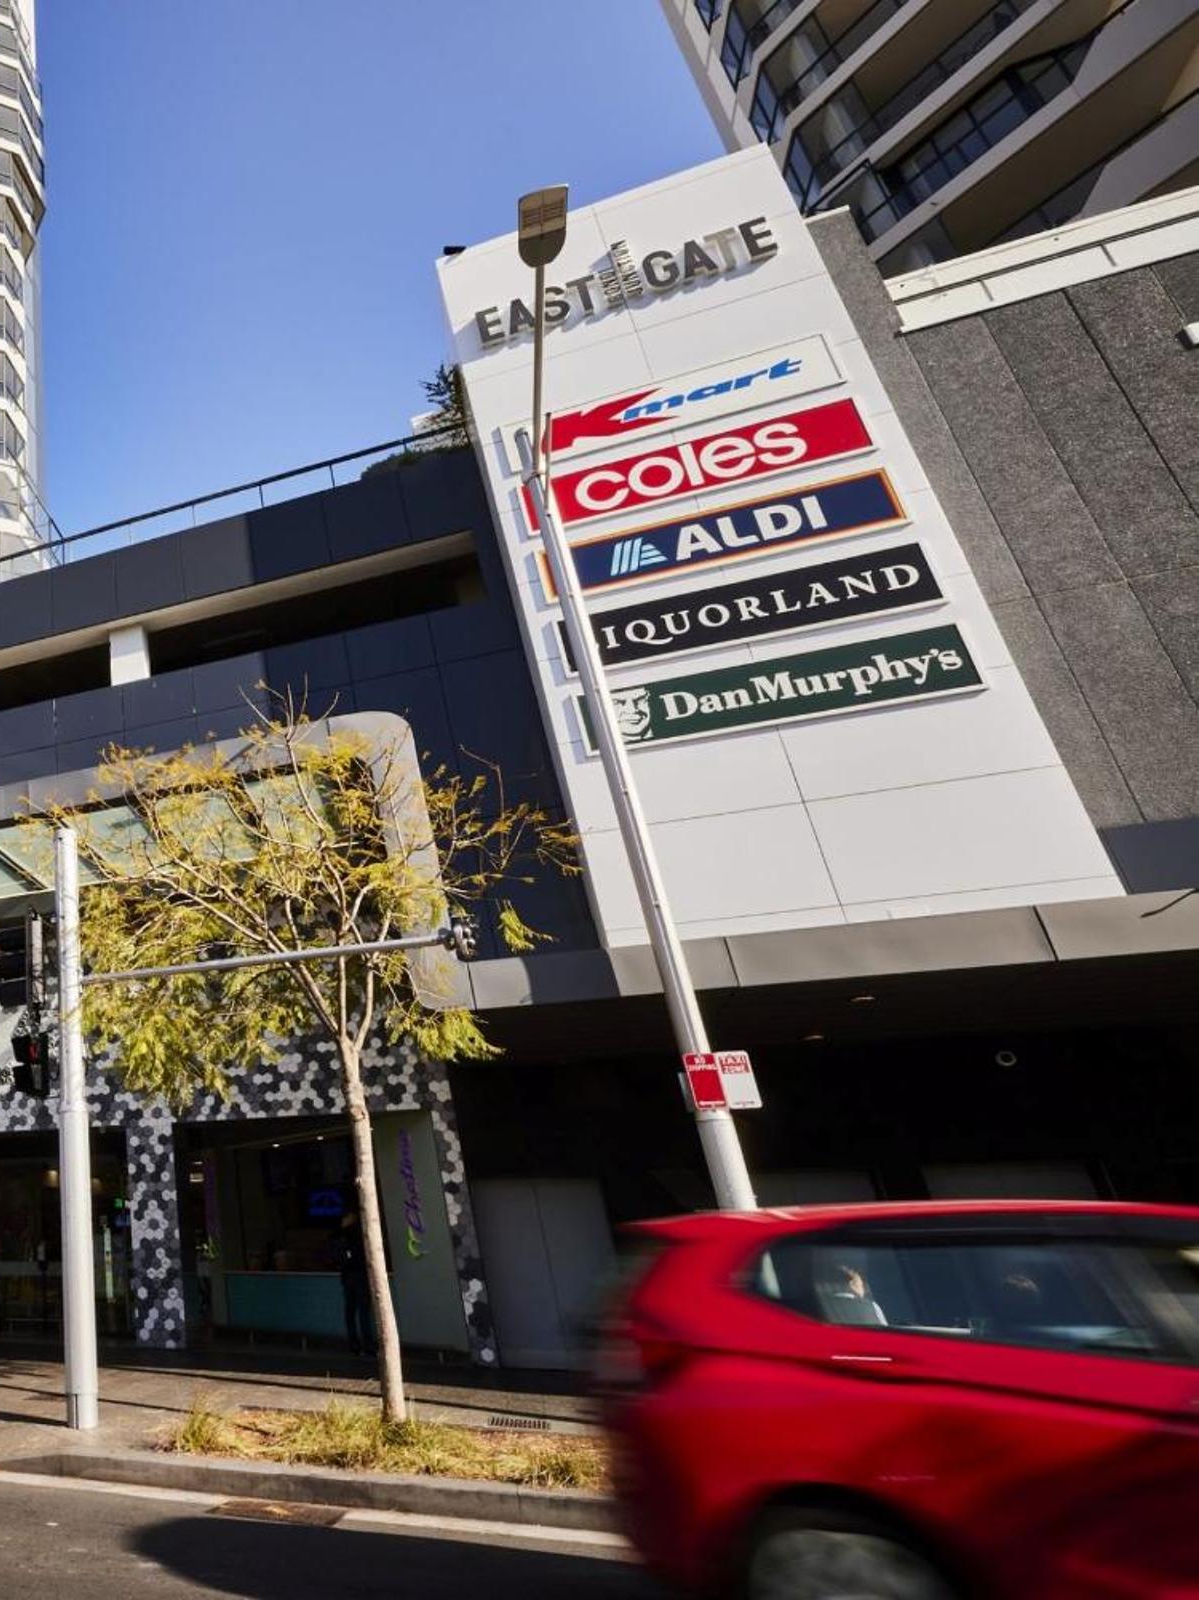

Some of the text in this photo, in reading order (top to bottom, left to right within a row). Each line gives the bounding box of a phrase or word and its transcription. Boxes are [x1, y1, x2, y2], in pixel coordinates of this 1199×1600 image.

[475, 216, 778, 344] EAST GATE
[575, 422, 808, 511] coles
[675, 496, 827, 562] ALDI
[596, 563, 920, 649] IQUORLAND
